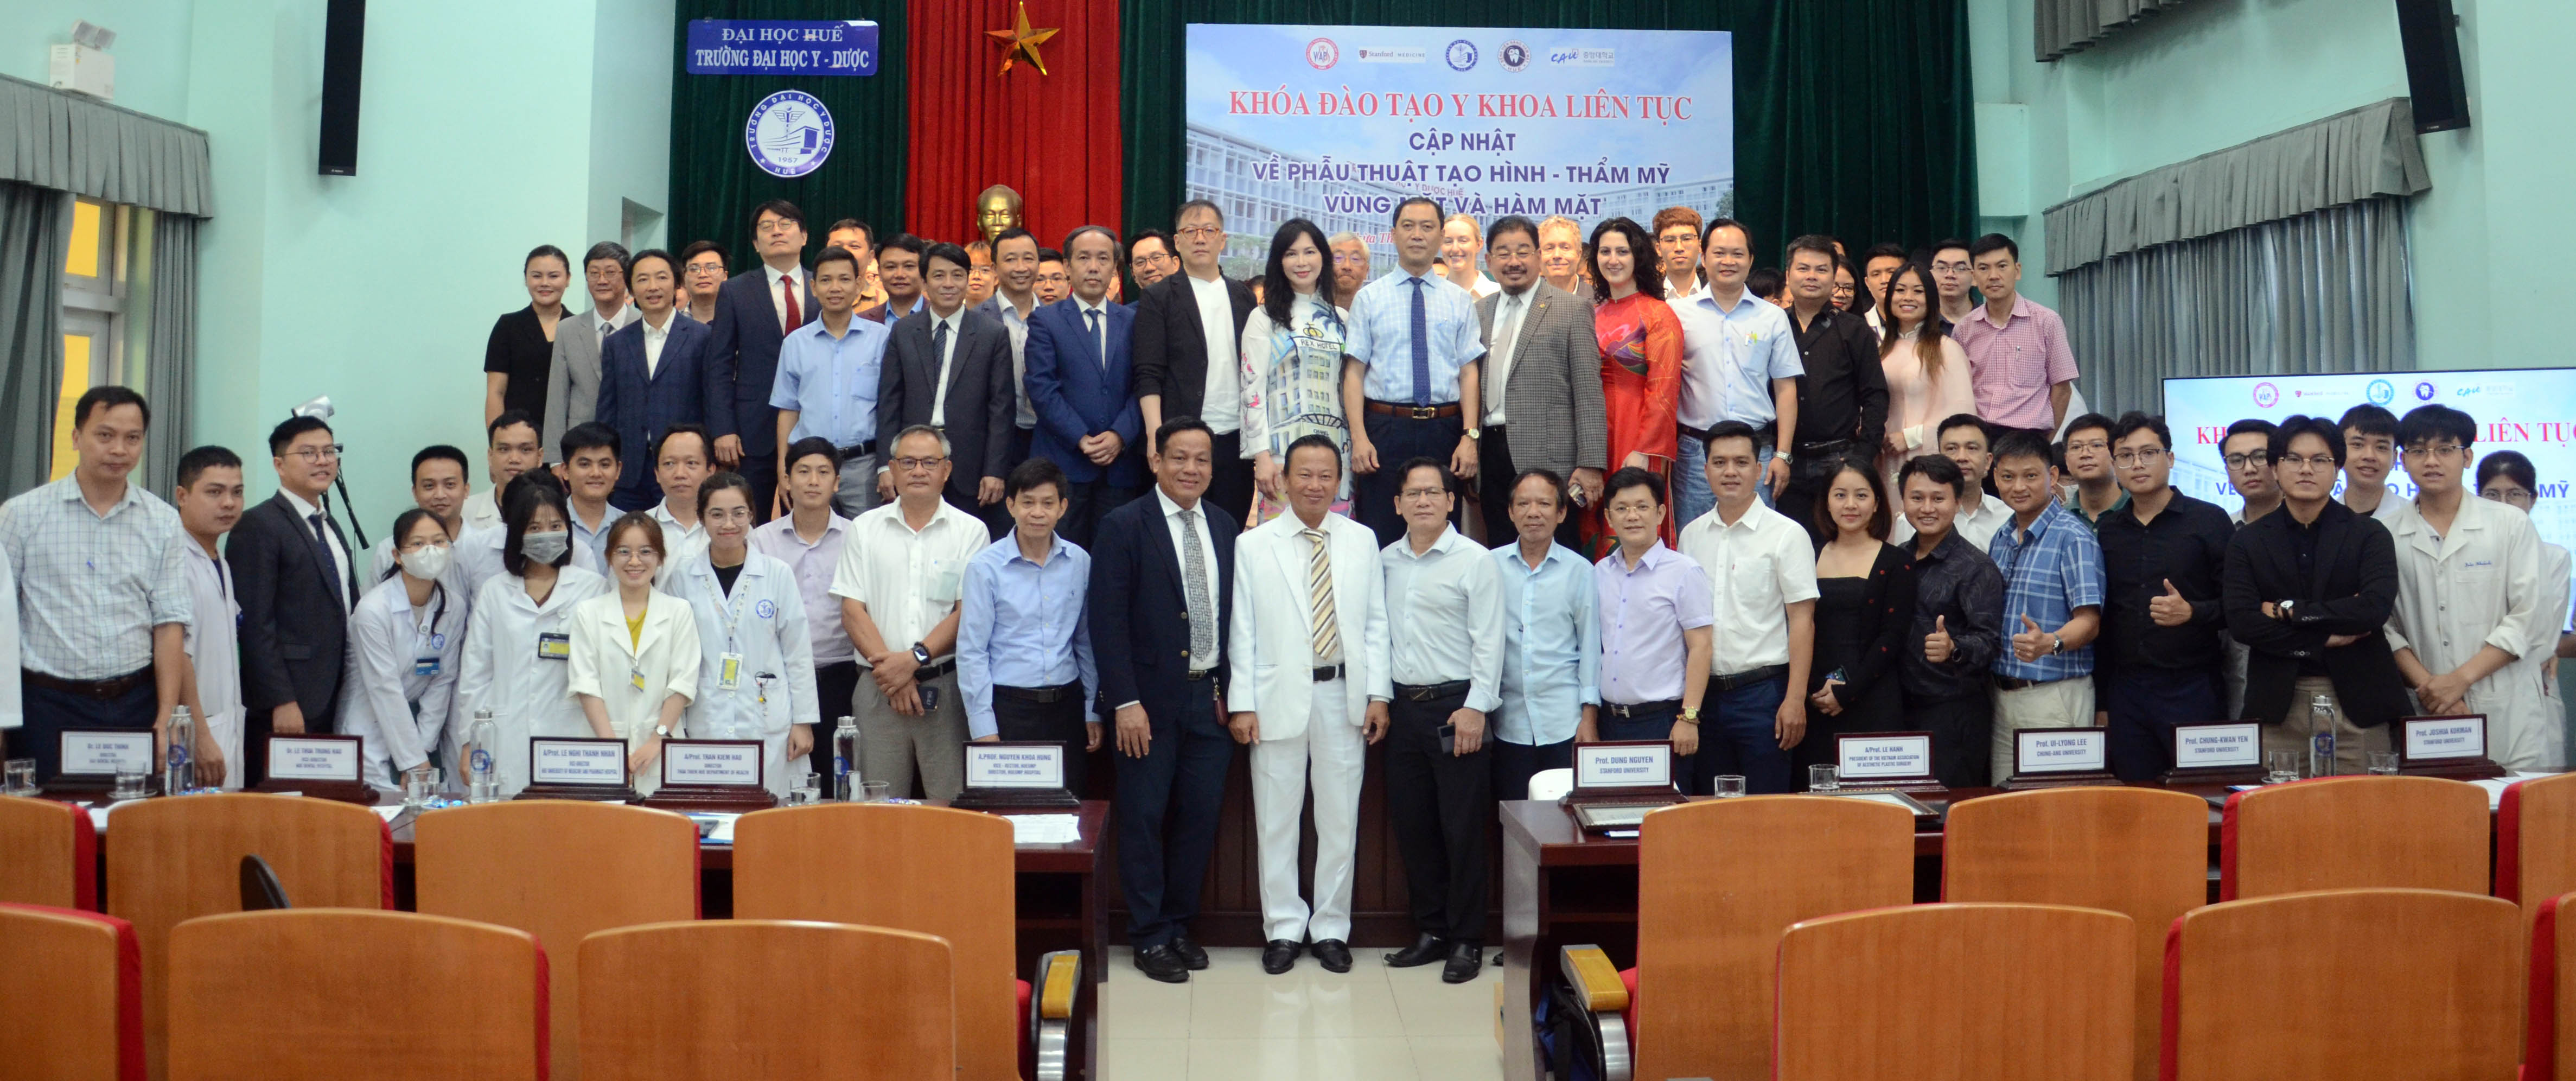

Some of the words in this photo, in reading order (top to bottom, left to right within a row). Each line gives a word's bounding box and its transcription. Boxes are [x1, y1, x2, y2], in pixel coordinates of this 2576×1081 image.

[722, 28, 754, 44] ĐẠI
[760, 28, 799, 44] HỌC
[803, 24, 844, 42] HUẾ
[696, 45, 749, 67] TRƯỜNG
[753, 49, 776, 71] ĐẠI
[780, 50, 808, 71] HỌC
[812, 50, 821, 67] Y
[833, 48, 869, 72] DƯỢC
[1228, 84, 1311, 115] KHÓA
[1318, 85, 1379, 116] ĐÀO
[1386, 93, 1444, 123] TẠO
[1451, 94, 1470, 117] Y
[1477, 94, 1558, 118] KHOA
[1565, 88, 1629, 119] LIÊN
[1637, 96, 1693, 126] TỤC
[1409, 127, 1454, 156] CẬP
[1461, 128, 1516, 156] NHẬT
[1252, 154, 1279, 180] VỀ
[1287, 155, 1349, 181] PHẪU
[1357, 160, 1429, 187] THUẬT
[1435, 164, 1482, 187] TẠO
[1490, 160, 1545, 182] HÌNH
[1566, 156, 1628, 184] THẨM
[1638, 162, 1670, 185] MỸ
[1324, 191, 1391, 213] VÙNG
[1455, 192, 1487, 214] VÀ
[1494, 192, 1545, 215] HÀM
[1554, 193, 1601, 220] MẶT
[2539, 480, 2570, 498] MỸ
